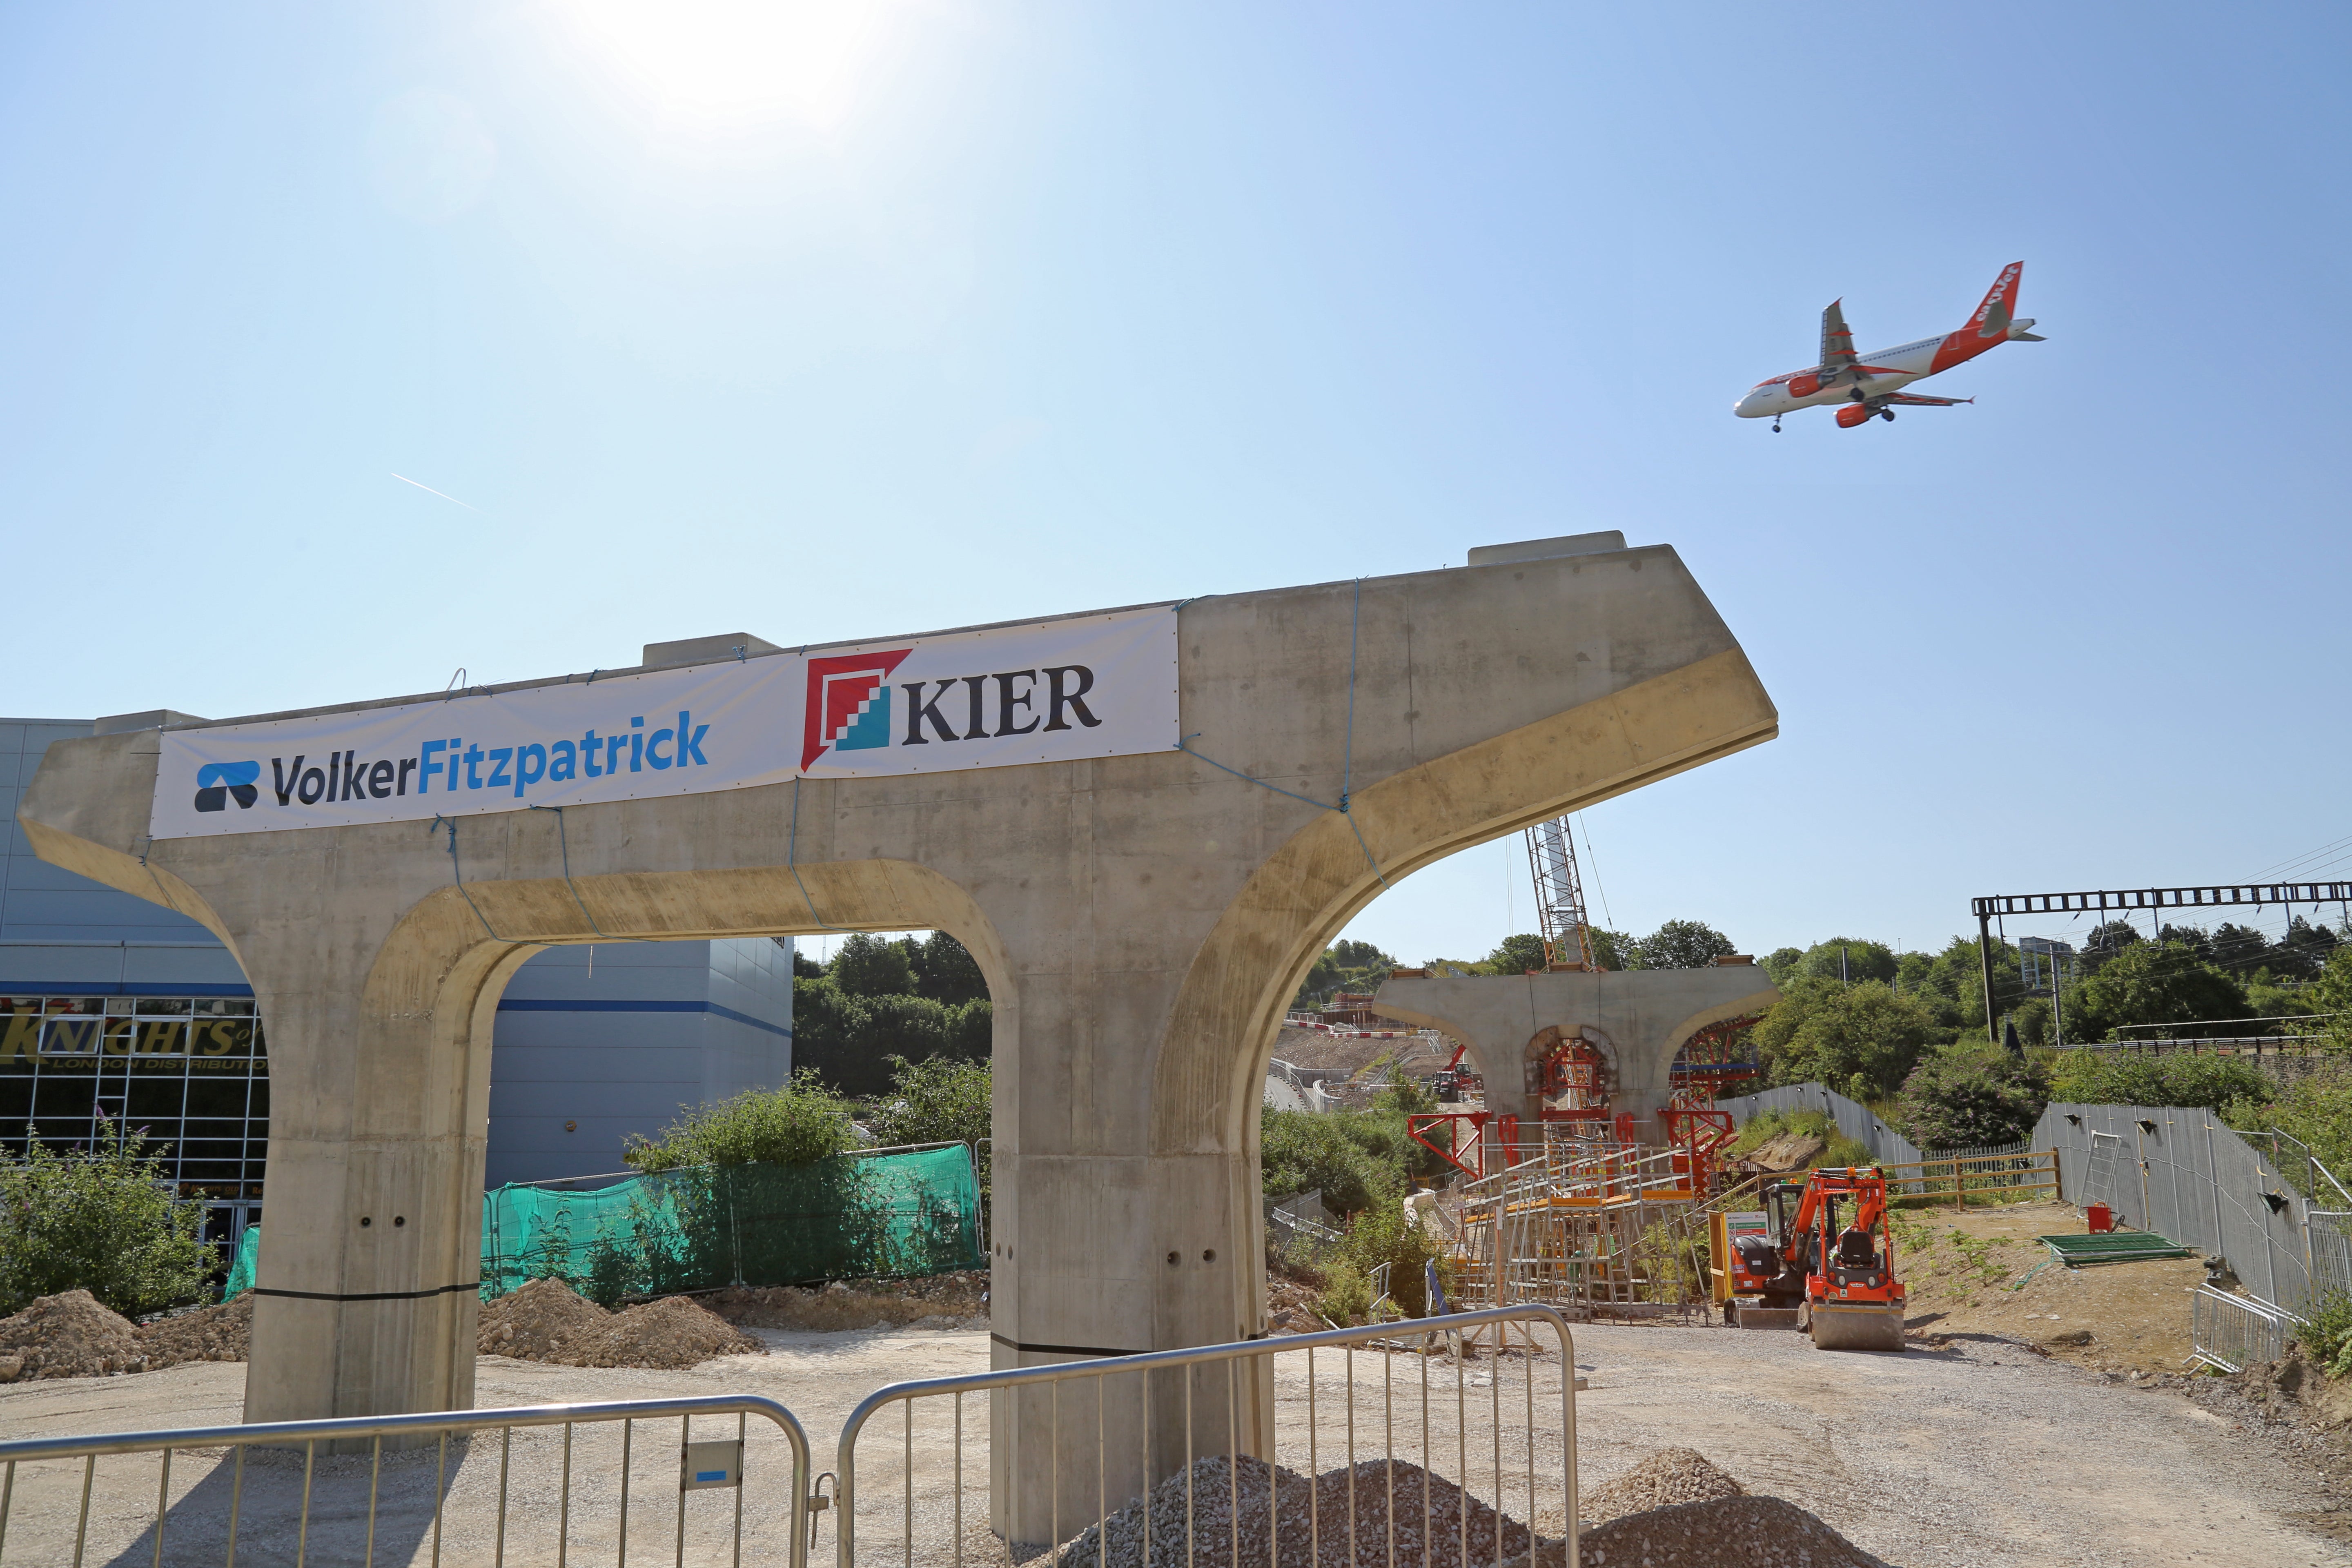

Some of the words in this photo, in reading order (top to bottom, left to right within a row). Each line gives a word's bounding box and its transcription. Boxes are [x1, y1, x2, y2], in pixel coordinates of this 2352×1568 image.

[272, 711, 709, 806] VolkerFitzpatrick
[901, 666, 1102, 746] KIER
[0, 1007, 236, 1064] KNIGHTS
[52, 1059, 139, 1069] LONDON
[145, 1060, 268, 1069] DISTRIBUTIO
